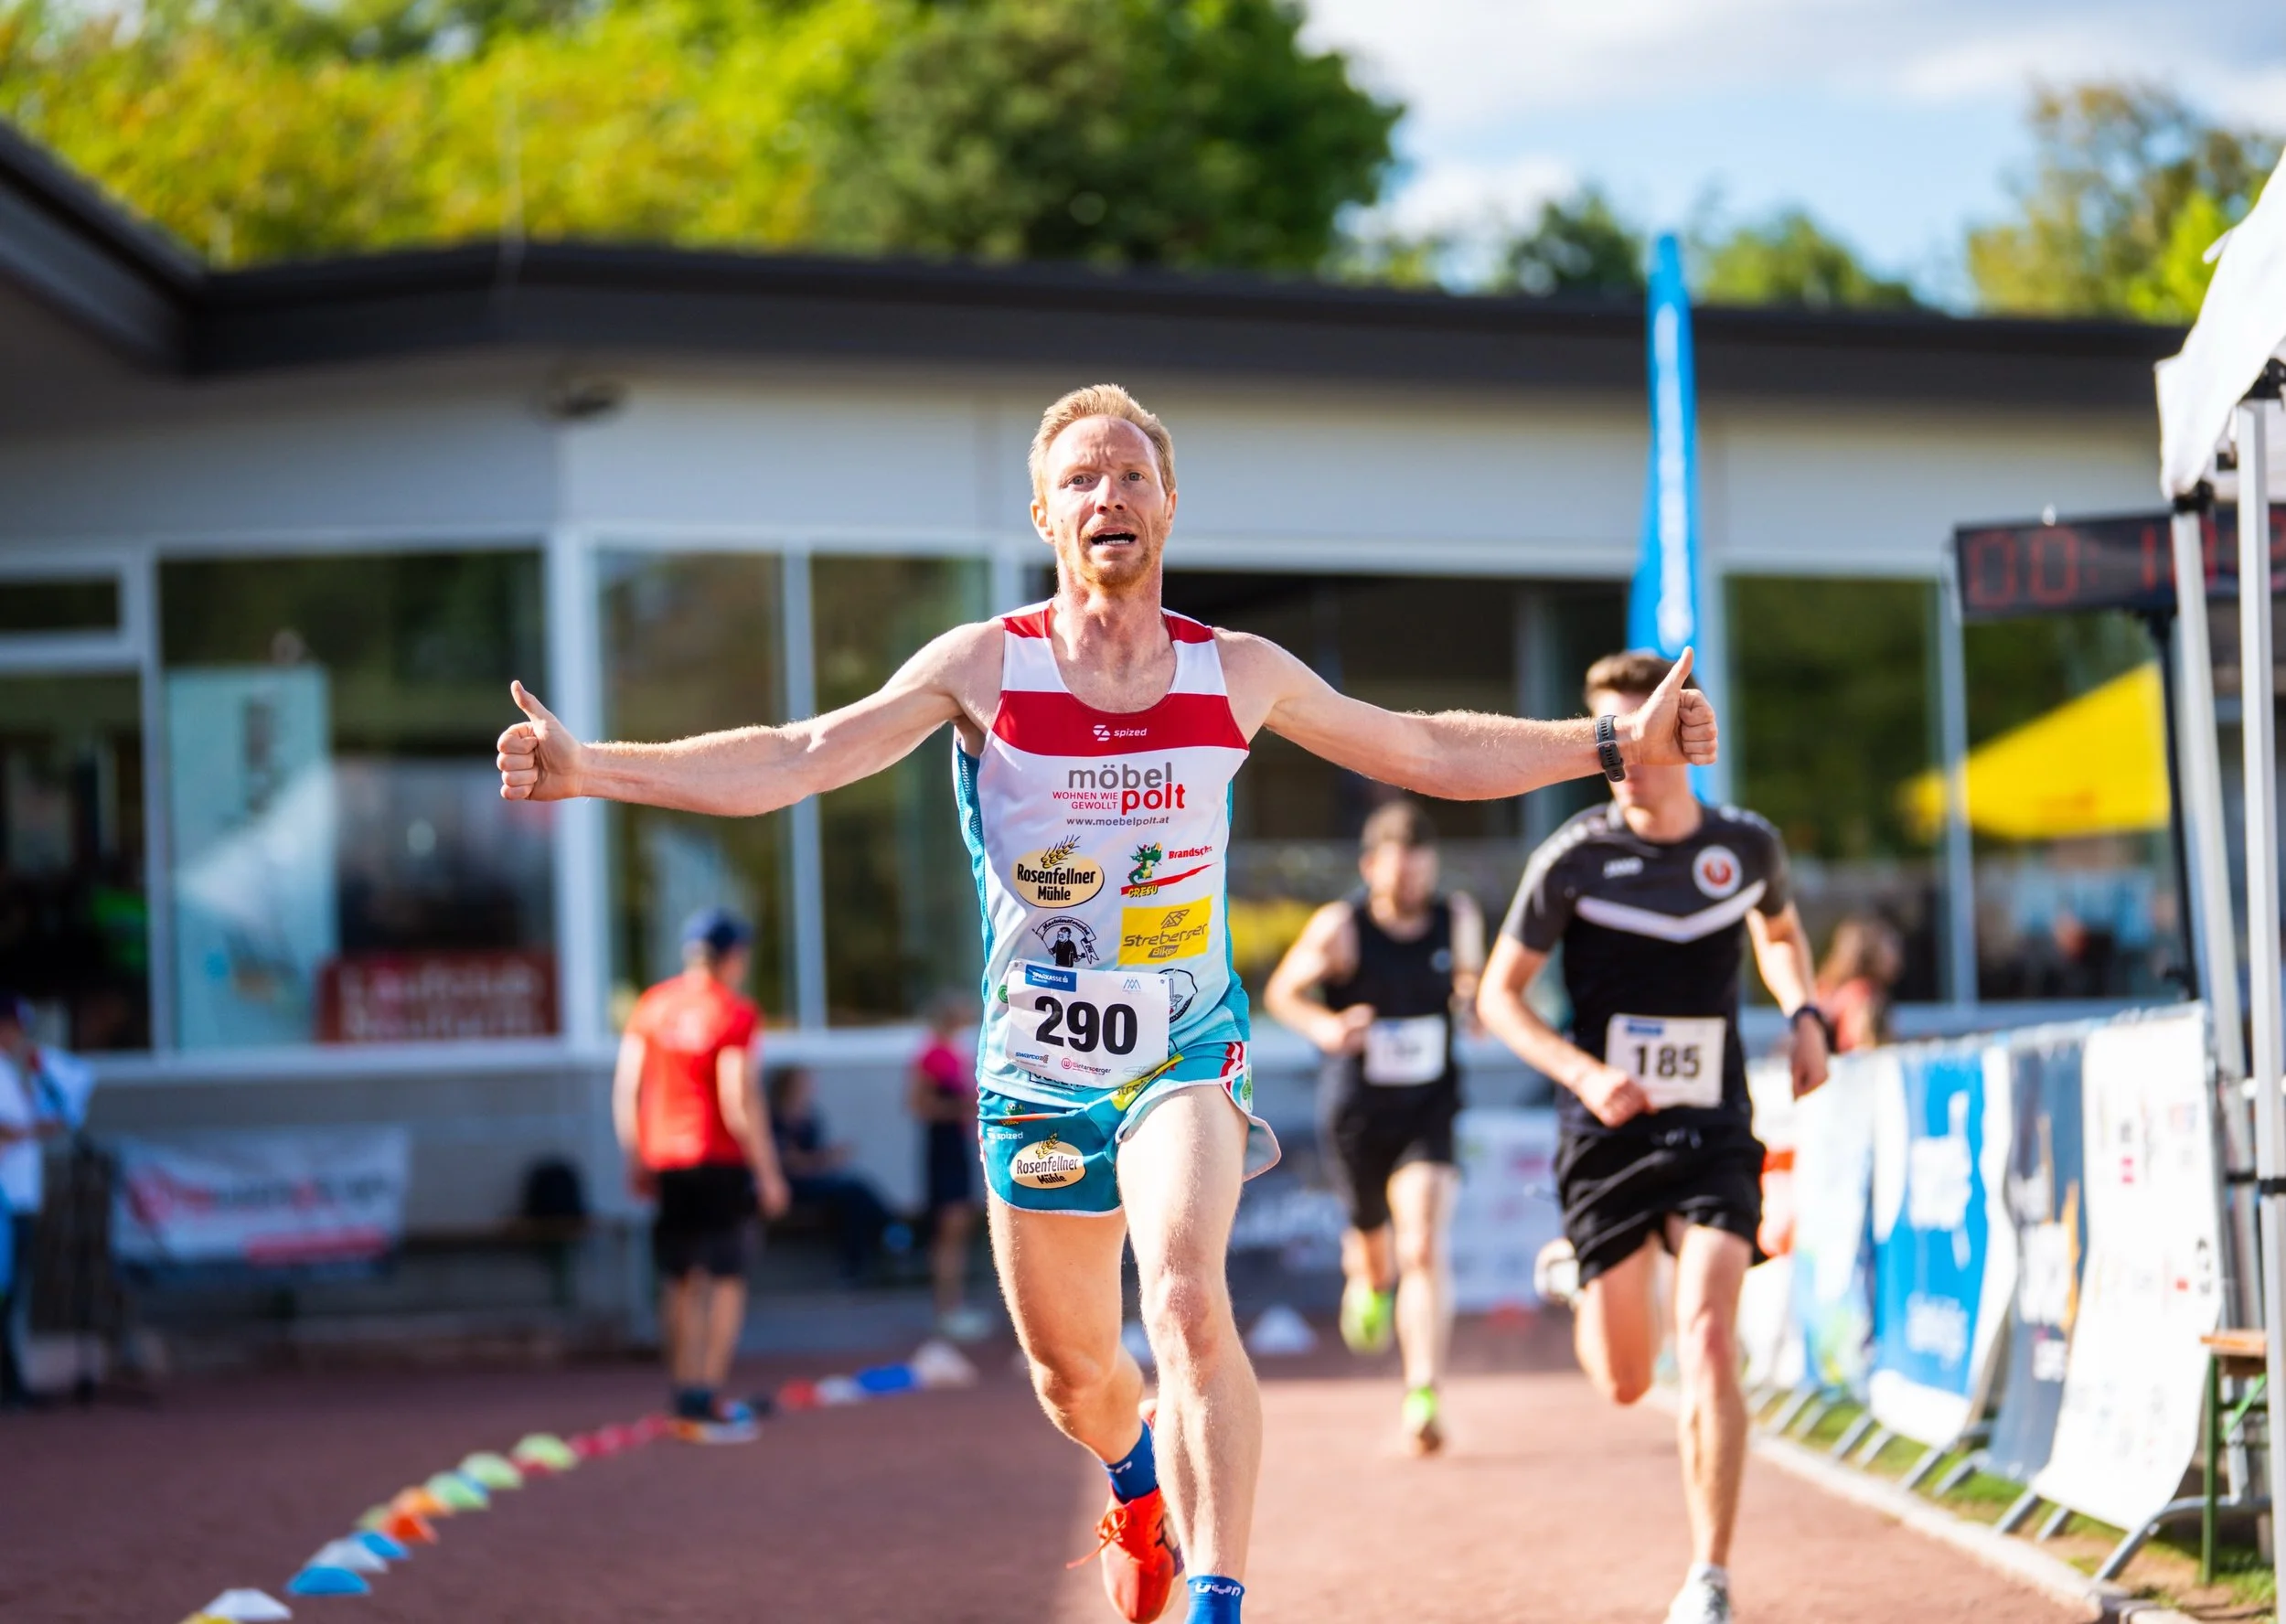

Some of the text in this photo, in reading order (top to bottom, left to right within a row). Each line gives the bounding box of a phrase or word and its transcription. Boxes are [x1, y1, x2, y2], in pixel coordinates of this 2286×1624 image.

[1114, 728, 1148, 738] spized
[1068, 762, 1172, 789] möbel
[1052, 791, 1118, 800] WOHNEN WIE
[1121, 783, 1186, 816] polt
[1071, 801, 1118, 810] GEWOLLT
[1066, 816, 1170, 827] www.moebelpolt.at
[1017, 863, 1095, 885] Rosenfellner
[1037, 885, 1071, 901] Mühle
[1034, 996, 1138, 1055] 290
[1634, 1044, 1702, 1079] 185
[997, 1131, 1023, 1141] spized
[1016, 1155, 1078, 1174] Rosenfellner
[1036, 1172, 1067, 1184] Mühle
